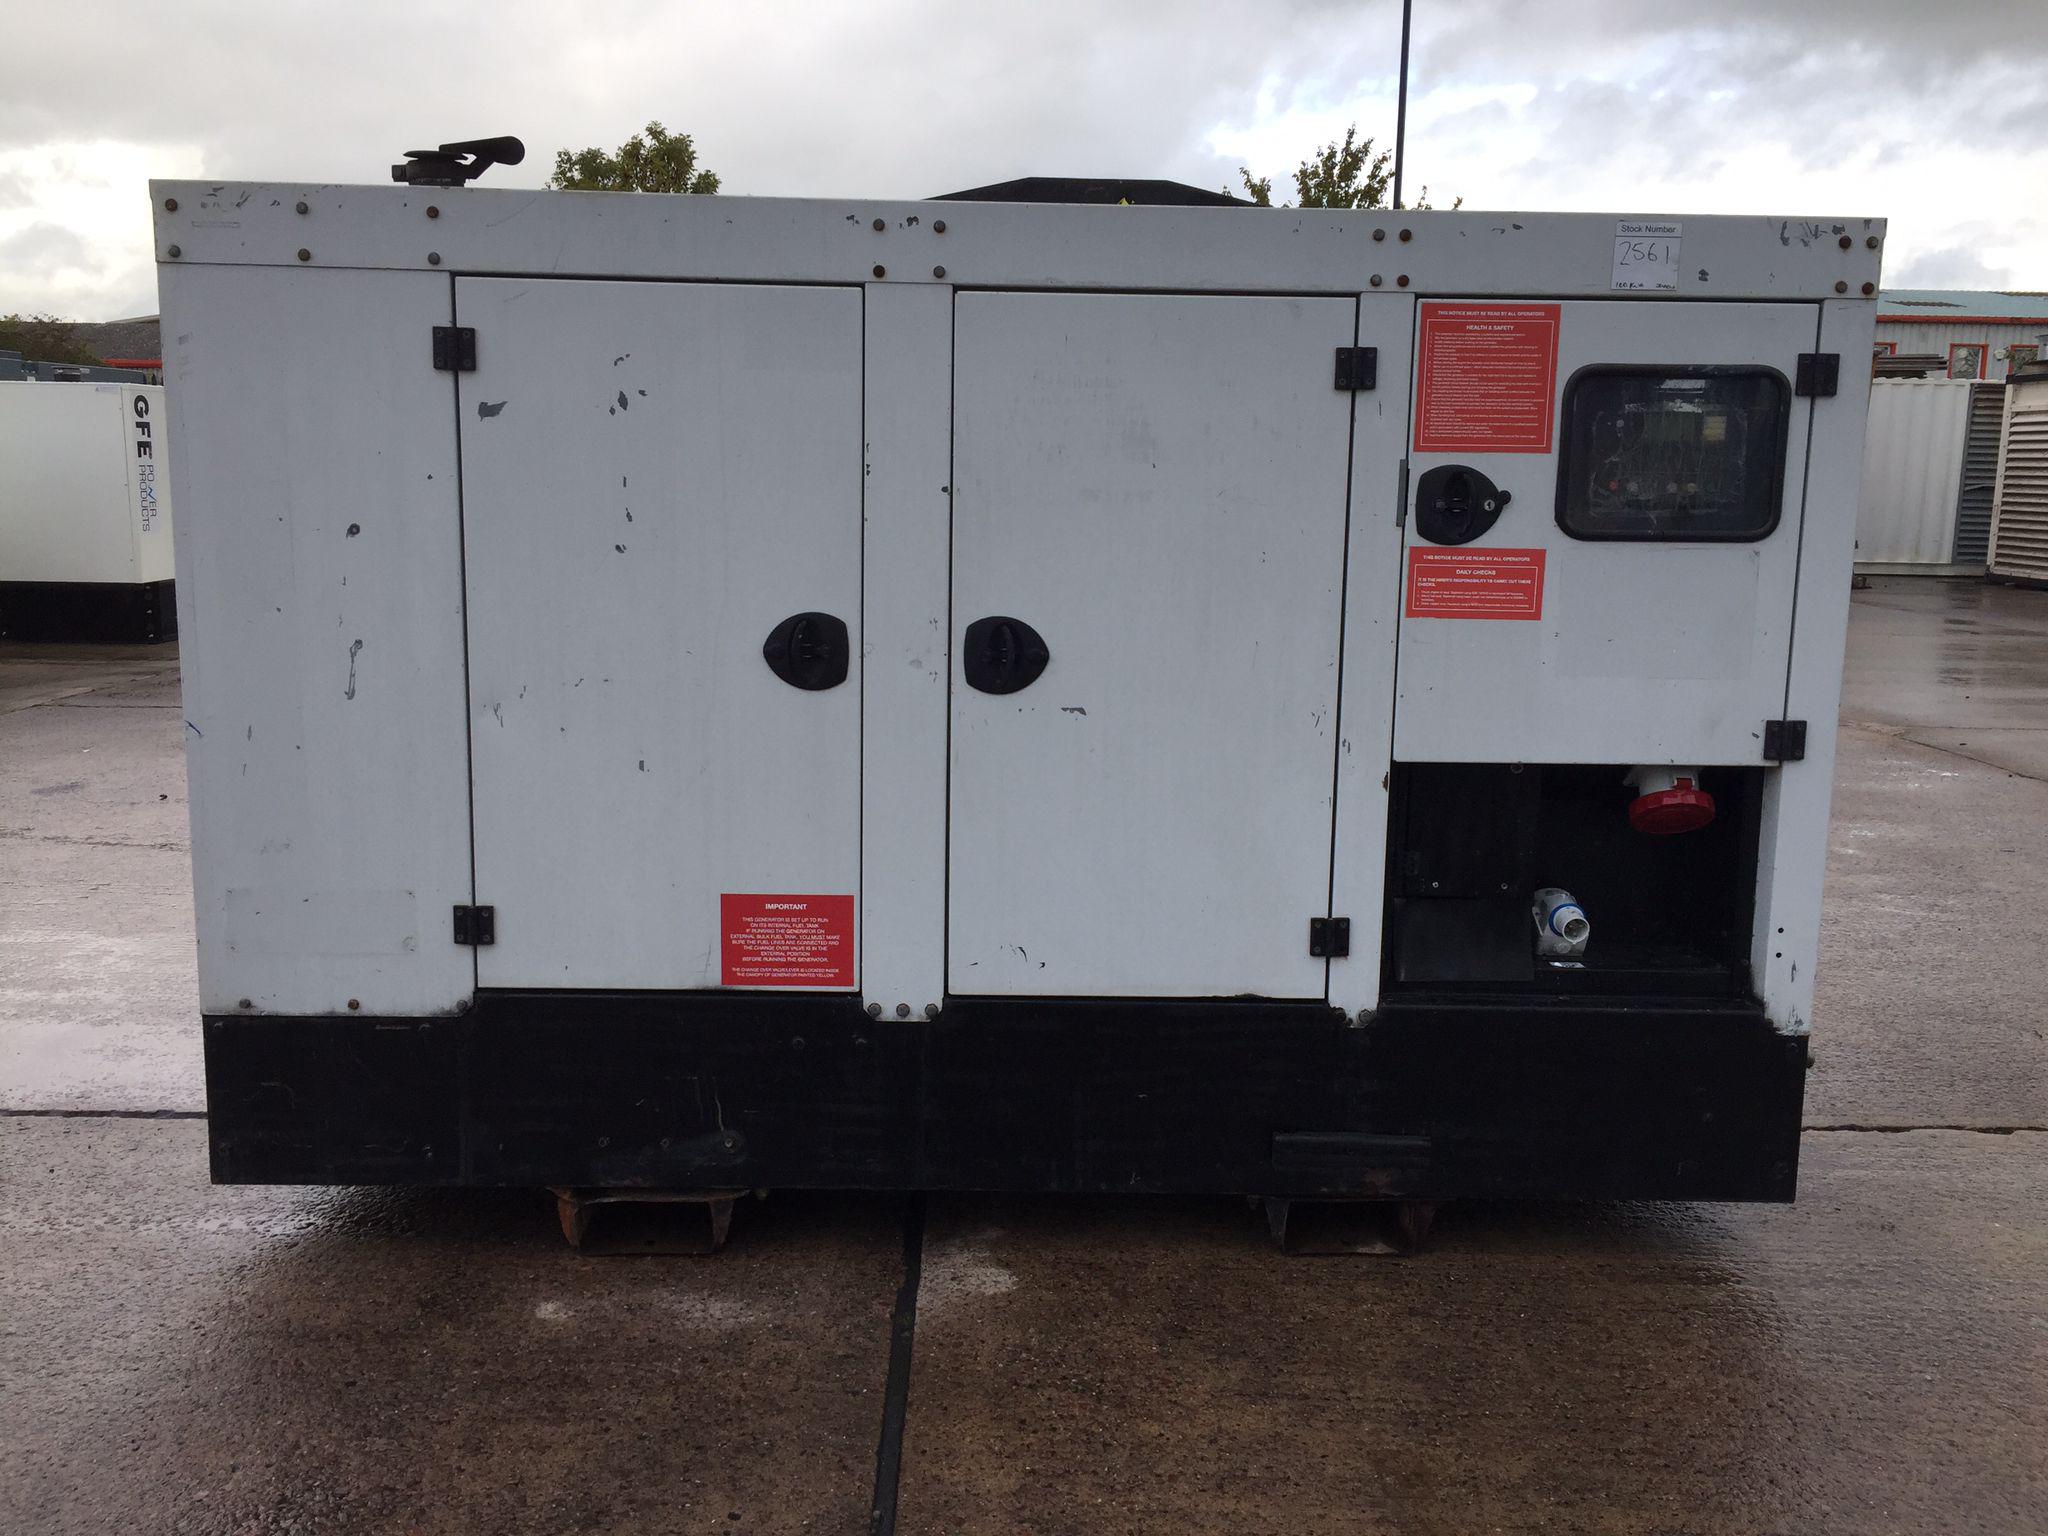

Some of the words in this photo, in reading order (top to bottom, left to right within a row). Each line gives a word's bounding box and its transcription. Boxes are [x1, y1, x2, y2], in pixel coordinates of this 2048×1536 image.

[1621, 224, 1643, 233] Stock
[1645, 225, 1676, 233] Number
[1619, 241, 1669, 265] 2561
[134, 395, 152, 460] GFE
[138, 464, 150, 532] PRODUCTS
